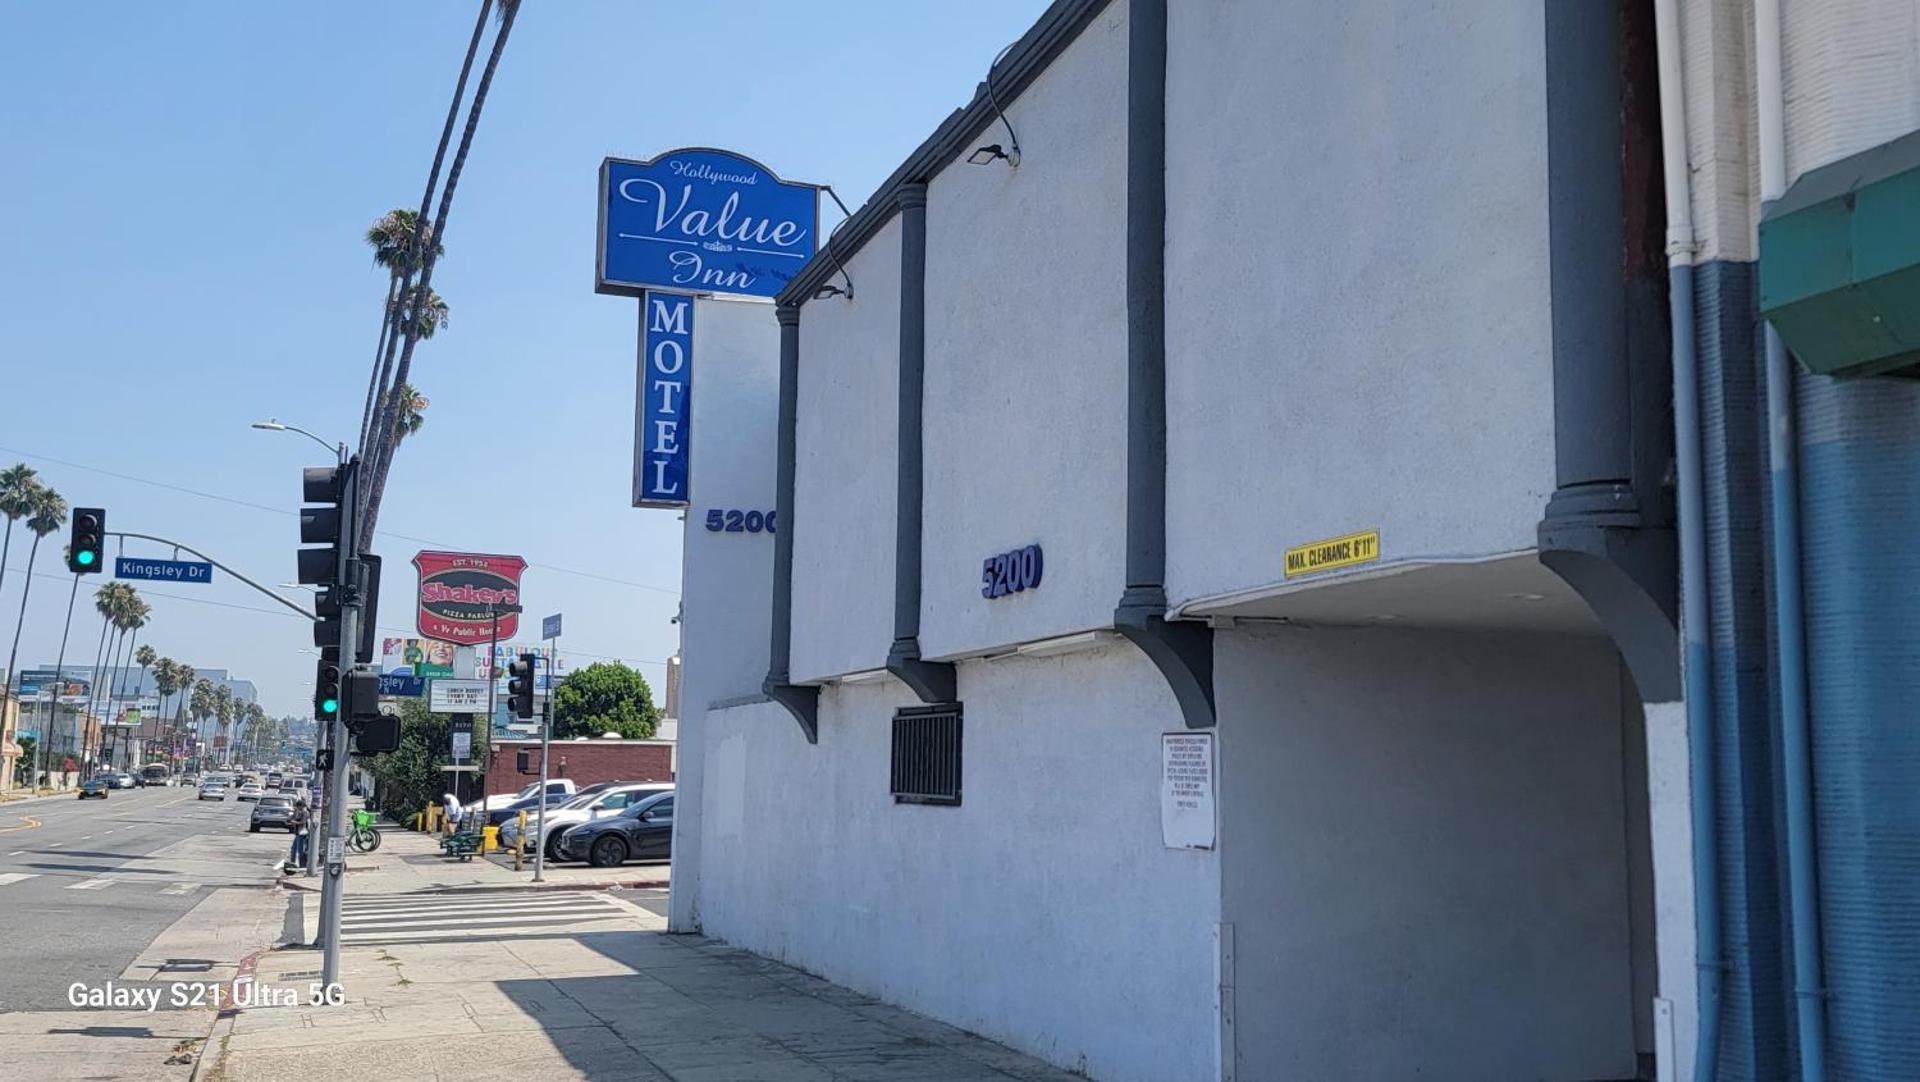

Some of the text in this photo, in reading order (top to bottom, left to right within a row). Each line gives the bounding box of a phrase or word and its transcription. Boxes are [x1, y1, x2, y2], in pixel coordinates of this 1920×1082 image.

[669, 160, 758, 185] Hollywood
[619, 178, 807, 246] Value
[669, 250, 756, 288] Inn
[650, 299, 689, 495] MOTEL
[122, 561, 205, 579] Kingsley Dr
[1308, 541, 1351, 567] CLEARANCE
[981, 543, 1044, 600] 5200
[442, 608, 465, 619] PIZZA
